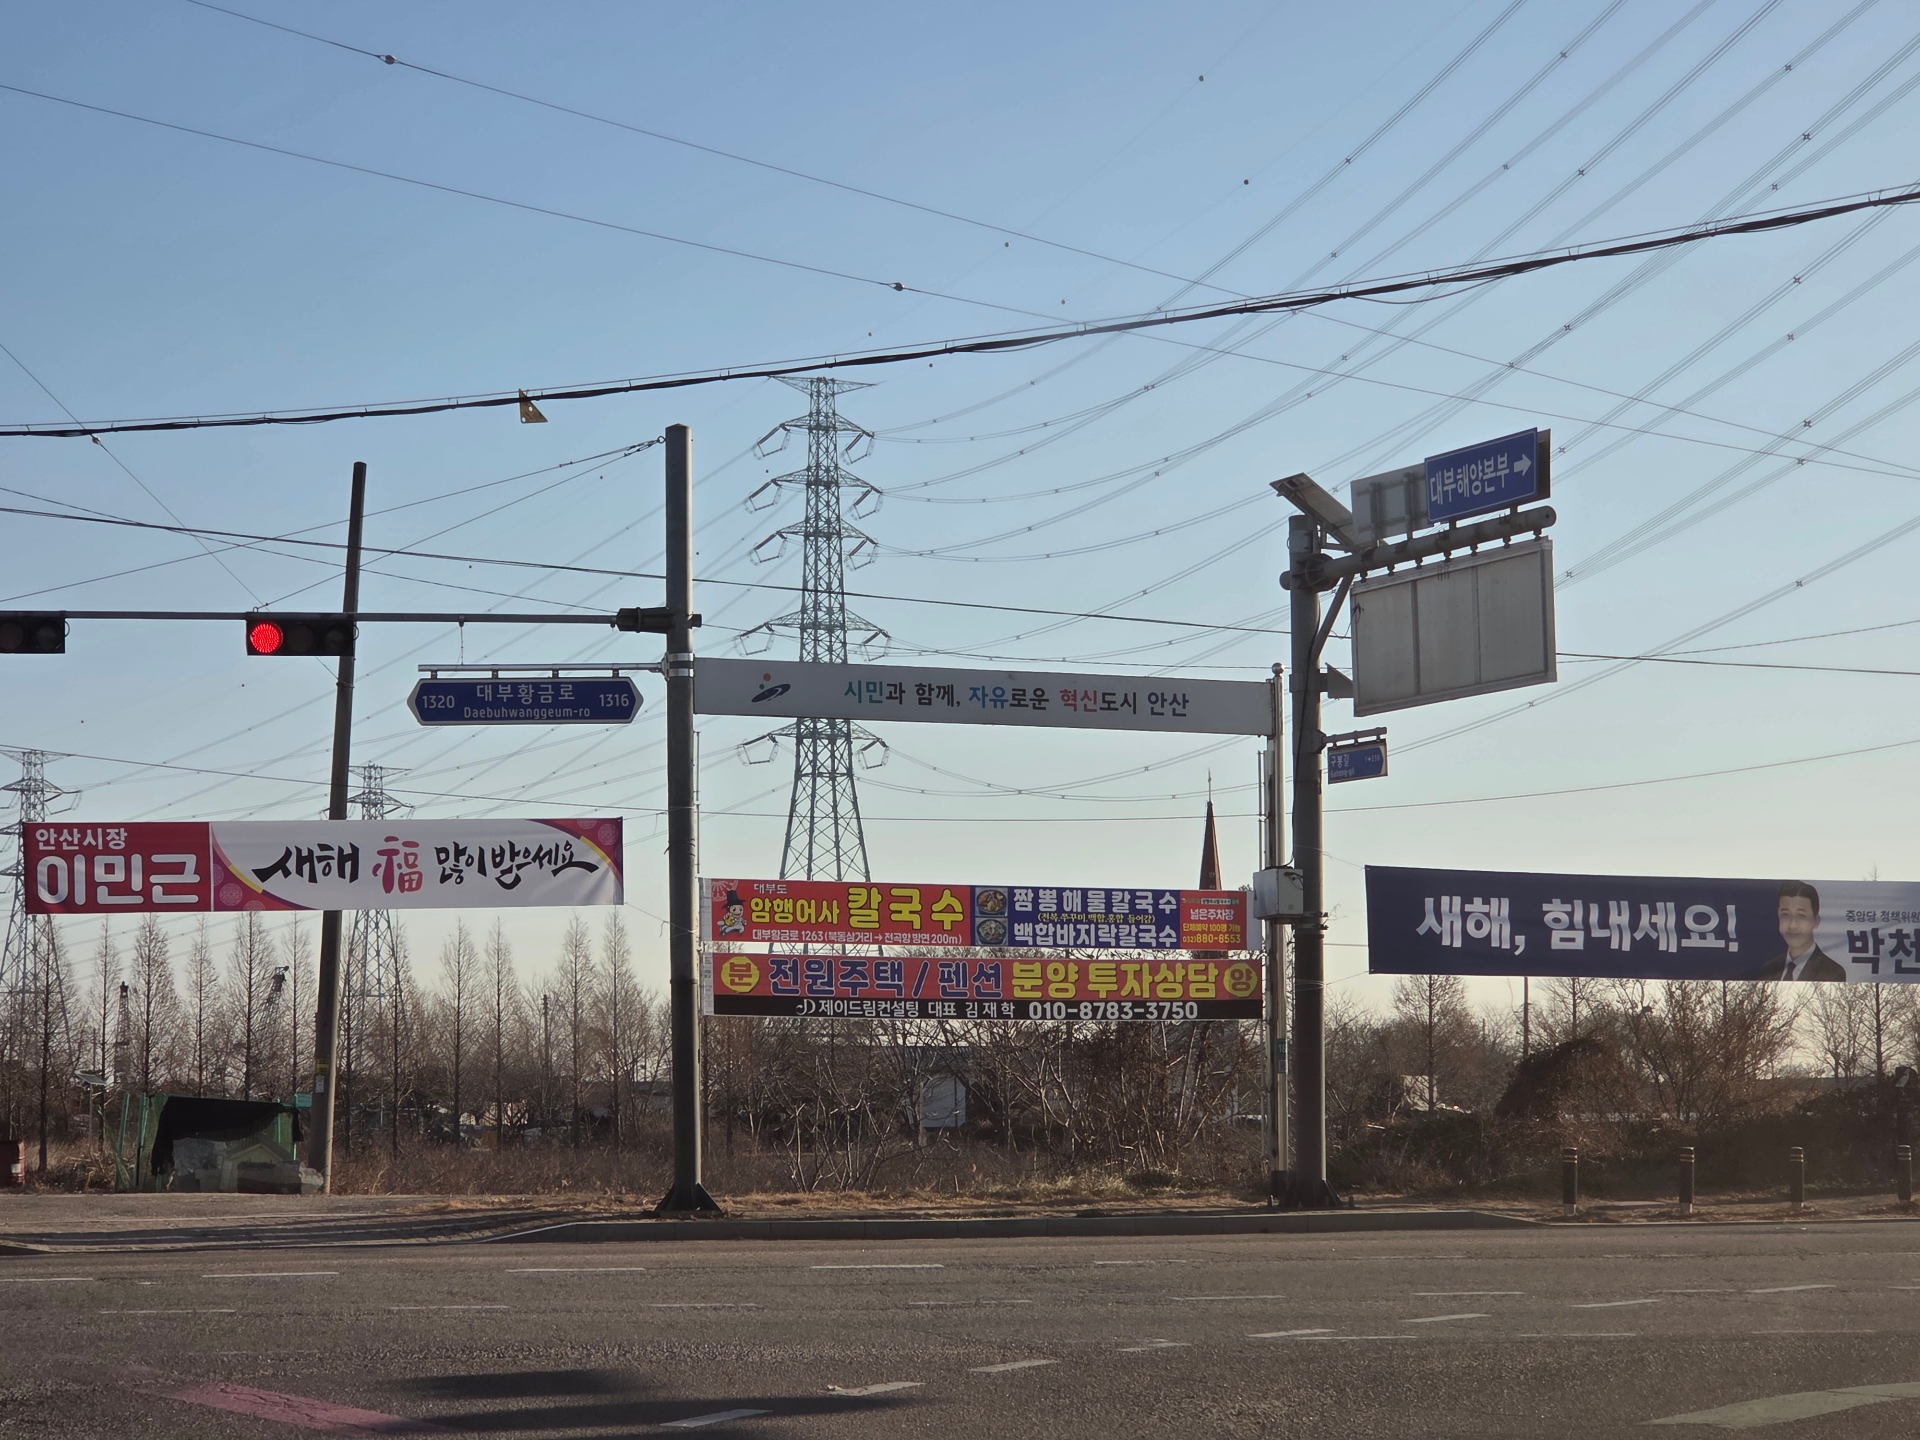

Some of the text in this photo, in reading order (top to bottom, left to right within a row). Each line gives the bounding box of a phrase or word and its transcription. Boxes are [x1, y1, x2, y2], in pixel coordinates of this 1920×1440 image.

[1429, 452, 1510, 505] 대부해양본부
[421, 695, 456, 709] 1320
[476, 684, 576, 705] 대부황금로
[599, 694, 630, 707] 1316
[844, 680, 1190, 717] 시민과 함께, 자유로운 혁신도시 안산
[463, 706, 592, 720] Daebuhwanggeum-ro
[35, 827, 128, 850] 안산시장
[251, 835, 601, 895] 새해 福 많이 받으세요
[37, 853, 201, 906] 이민근
[753, 884, 788, 895] 대부도
[750, 886, 965, 931] 암행어사 칼국수
[1013, 888, 1178, 914] 짬뽕해물칼국수
[1190, 908, 1234, 920] 넓은주차장
[1416, 896, 1739, 956] 새해, 힘내세요!
[1845, 910, 1877, 923] 중앙당
[752, 929, 799, 941] 대부황금로
[801, 930, 824, 942] 1263
[912, 933, 930, 944] 방면
[1013, 922, 1178, 948] 백합바지락칼국수
[728, 962, 753, 987] 분
[768, 958, 905, 998] 전원주택
[938, 961, 1003, 999] 펜션
[1011, 961, 1079, 999] 분양
[1087, 963, 1219, 999] 투자상담
[1230, 967, 1253, 992] 양
[818, 1000, 919, 1018] 제이드림컨설팅
[927, 1002, 958, 1017] 대표
[1028, 1001, 1198, 1020] 010-8783-3750
